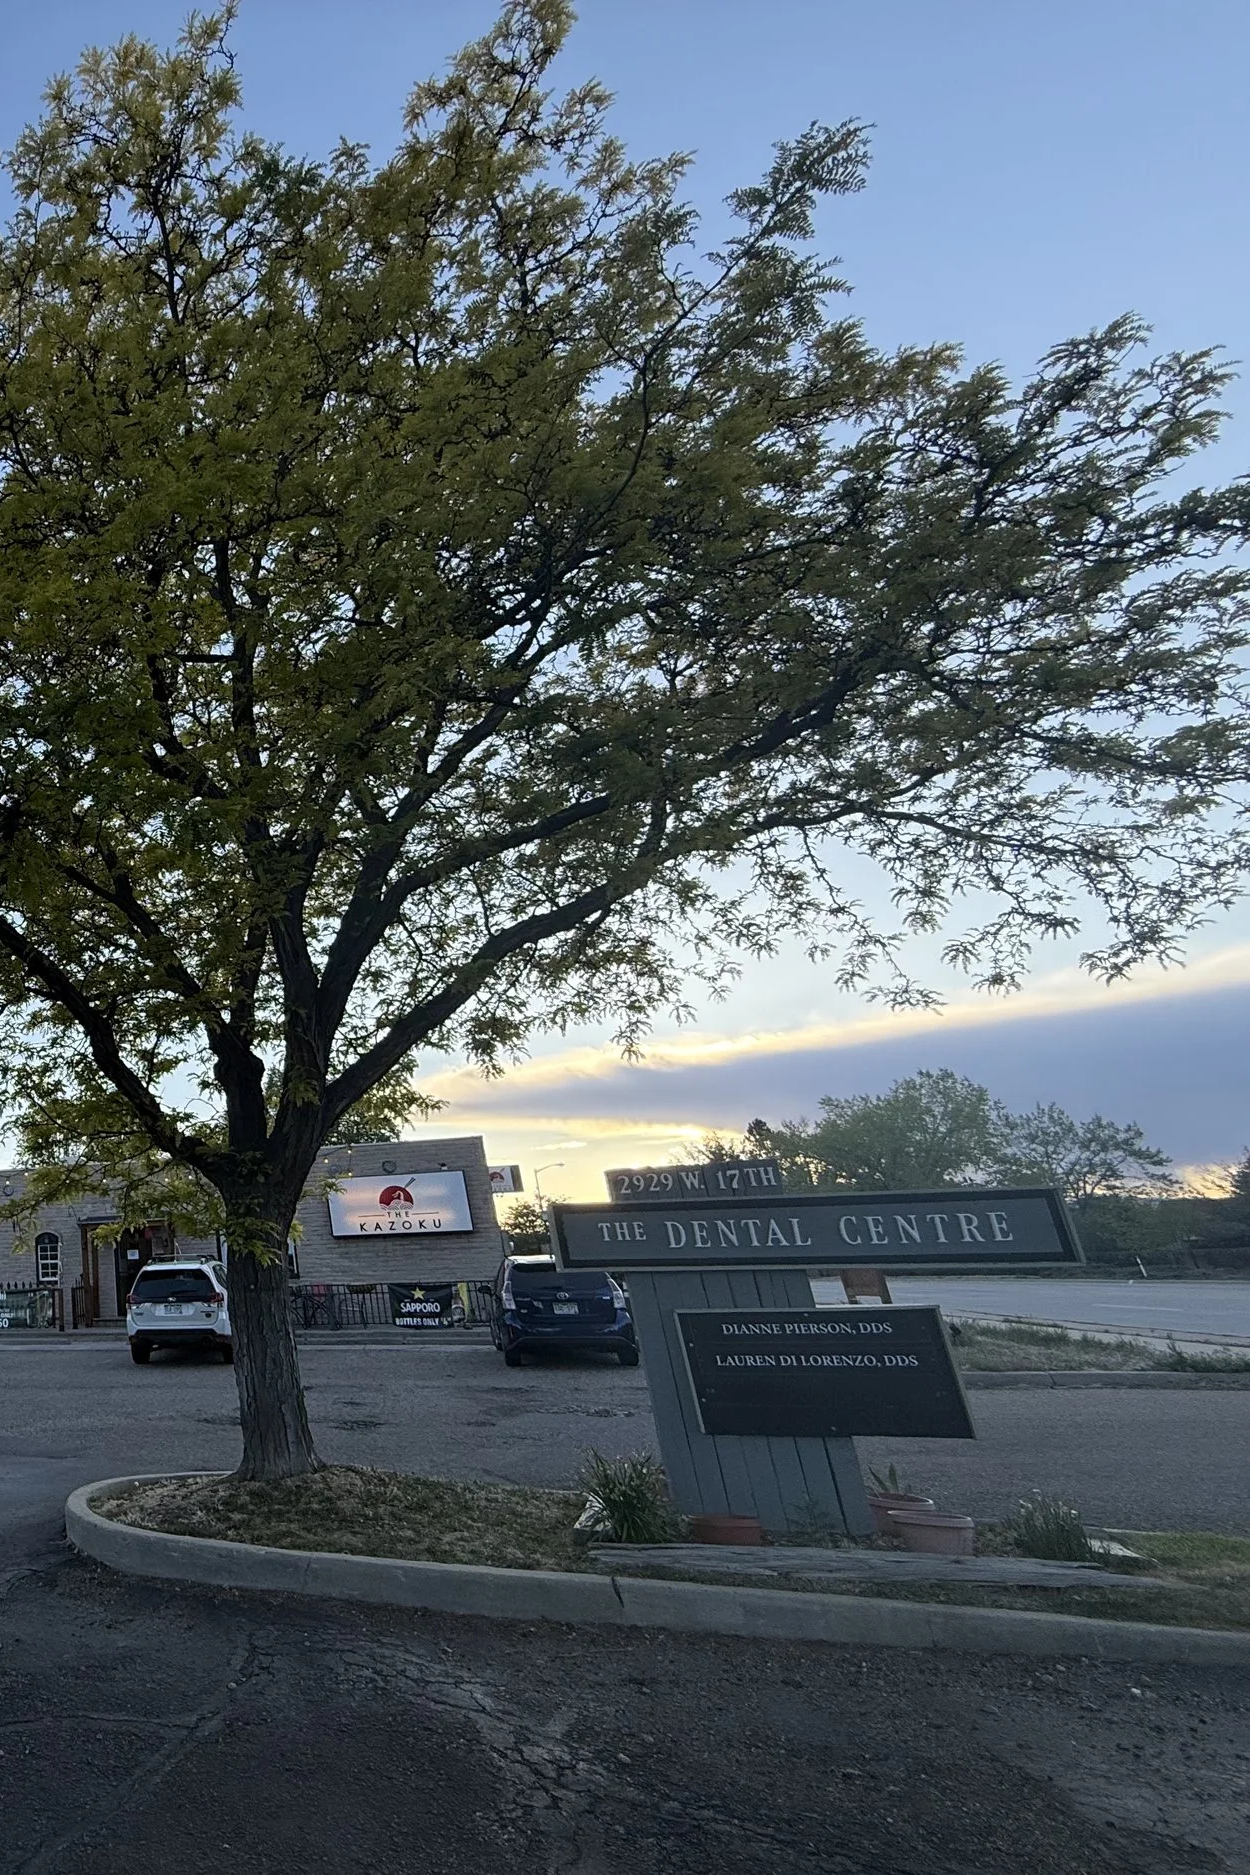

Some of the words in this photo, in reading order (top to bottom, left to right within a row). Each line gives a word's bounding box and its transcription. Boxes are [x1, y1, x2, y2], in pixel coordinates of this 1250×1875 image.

[617, 1173, 674, 1194] 2929
[680, 1171, 705, 1190] W.
[386, 1210, 410, 1218] THE
[359, 1218, 442, 1232] KAZOKU
[597, 1221, 647, 1241] THE
[663, 1217, 812, 1248] DENTAL
[838, 1211, 1014, 1245] CENTRE
[400, 1302, 441, 1313] SAPPORO
[395, 1317, 422, 1326] BOTTLES
[422, 1317, 440, 1326] ONLY
[722, 1323, 783, 1335] DIANNE
[785, 1322, 857, 1335] PIERSON,
[858, 1322, 893, 1334] DDS
[716, 1355, 776, 1367] LAUREN
[780, 1355, 798, 1367] DI
[800, 1355, 882, 1368] LORENZO,
[884, 1355, 919, 1367] DDS
